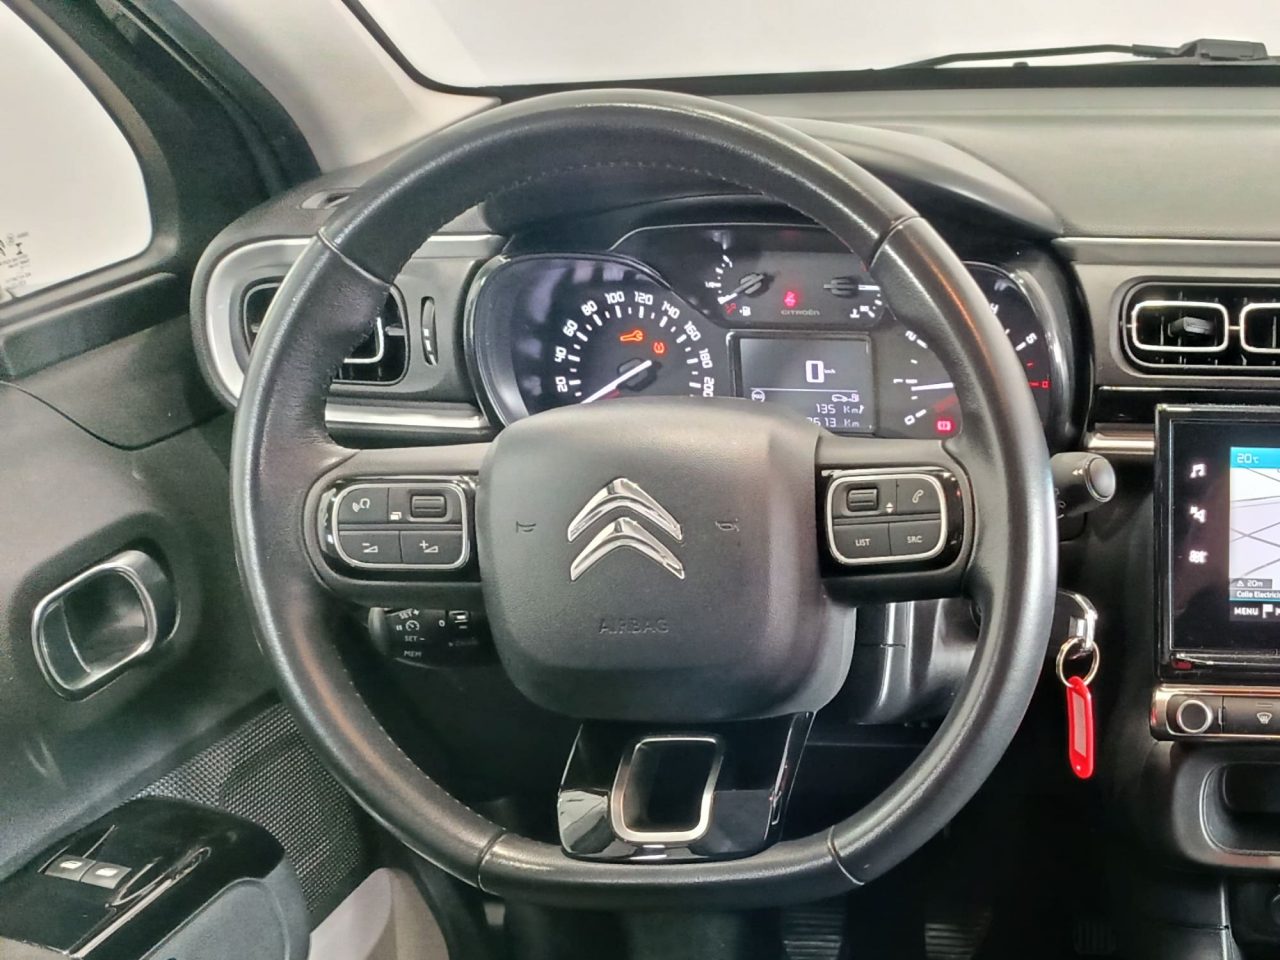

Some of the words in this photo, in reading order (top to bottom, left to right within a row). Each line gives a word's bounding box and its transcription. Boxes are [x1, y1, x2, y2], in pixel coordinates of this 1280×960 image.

[604, 291, 625, 305] 100
[634, 291, 653, 305] 120
[581, 300, 598, 317] 80
[661, 301, 680, 319] 140
[562, 319, 578, 337] 60
[684, 320, 701, 341] 160
[905, 330, 917, 342] 2
[554, 346, 567, 363] 40
[699, 348, 713, 369] 180
[805, 360, 825, 383] 0
[555, 376, 568, 392] 20
[702, 376, 715, 397] 200
[816, 403, 836, 414] 135
[904, 414, 916, 426] 0
[855, 538, 871, 547] LIST
[906, 535, 923, 544] SRC
[1233, 606, 1259, 616] MENU
[600, 618, 669, 634] AIRBAG
